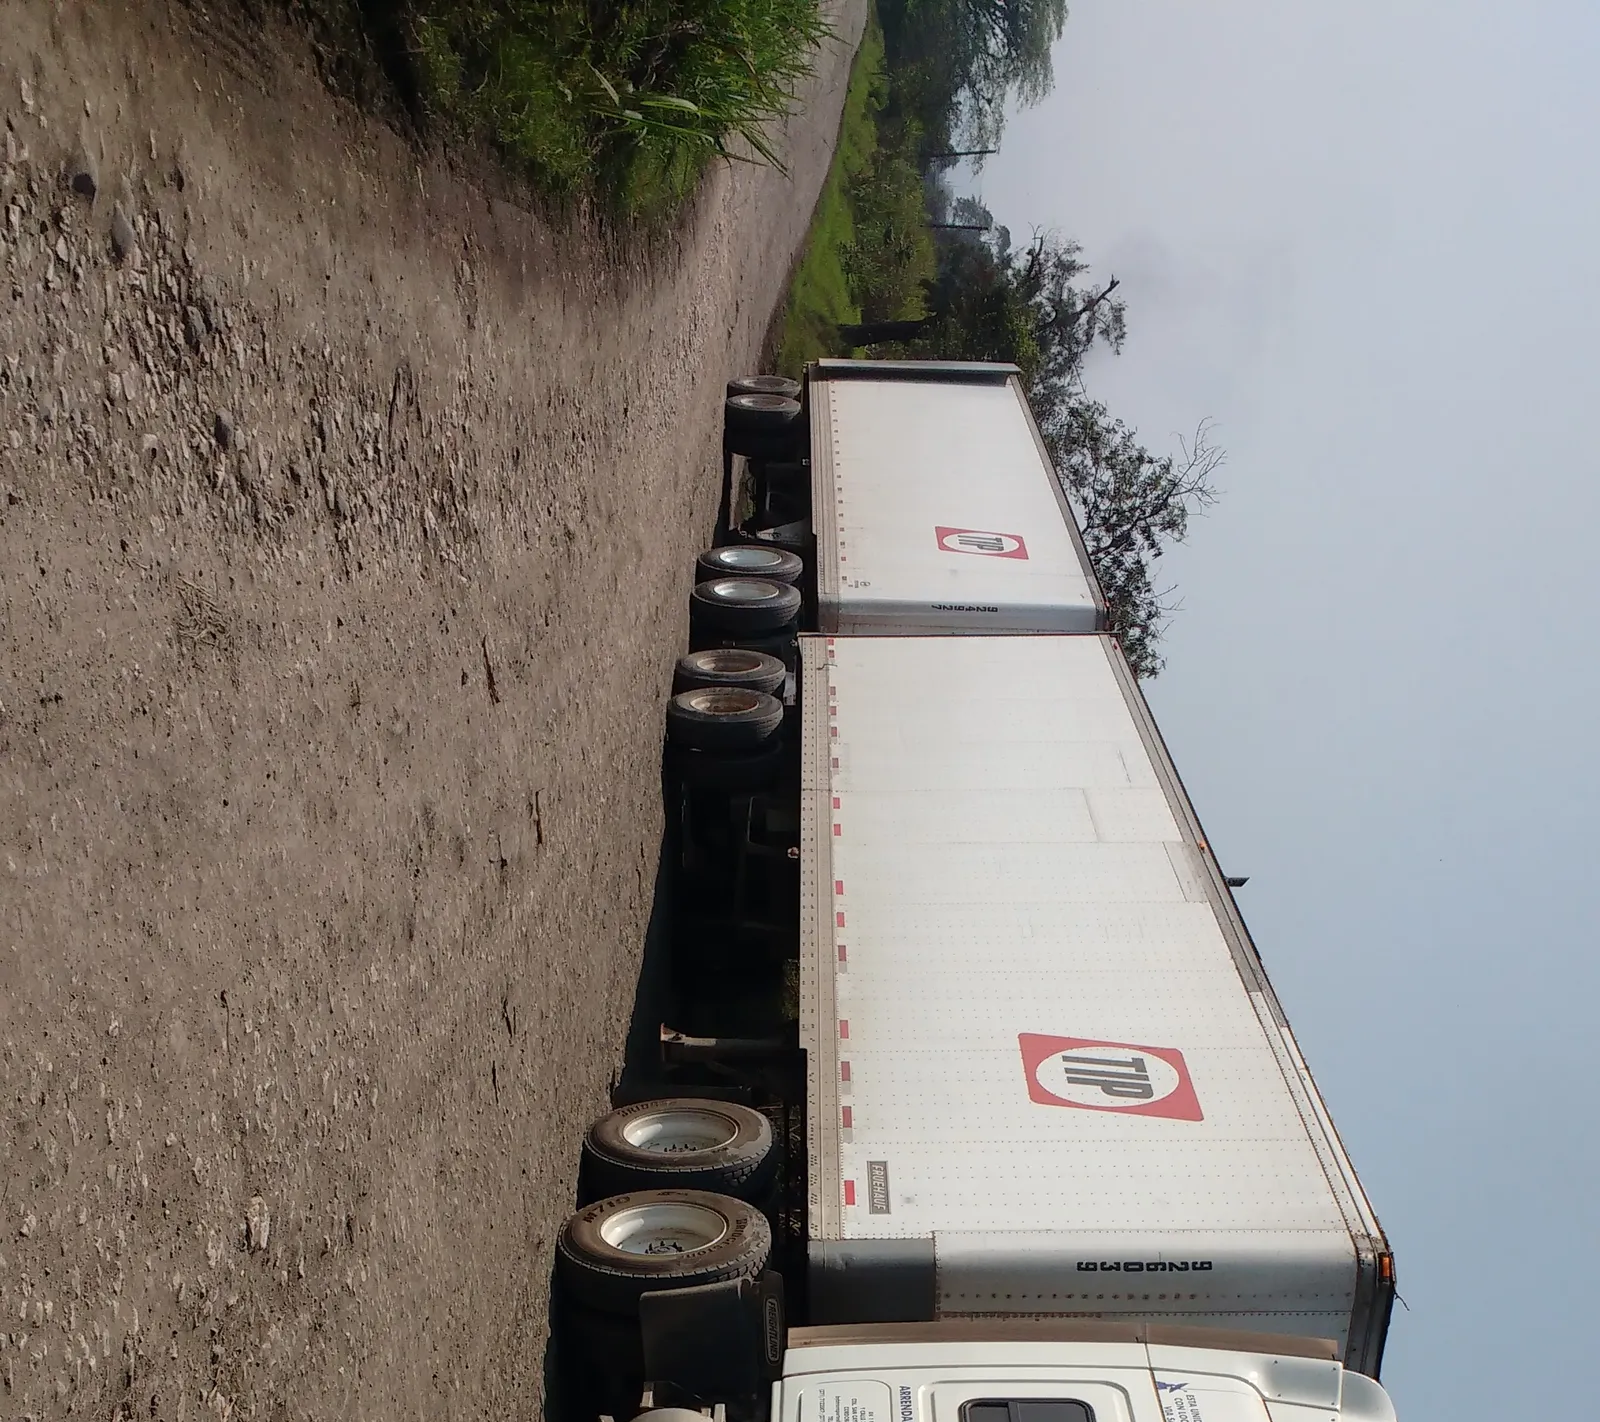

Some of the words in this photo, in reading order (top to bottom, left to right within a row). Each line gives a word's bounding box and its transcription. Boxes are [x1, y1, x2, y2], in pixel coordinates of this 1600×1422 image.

[958, 536, 1004, 551] TIP
[931, 605, 998, 613] 924927
[1062, 1055, 1154, 1099] TIP
[872, 1164, 886, 1210] FRUEHAUF
[1077, 1261, 1213, 1273] 926039
[768, 1301, 778, 1359] FREIGHTLINER
[1174, 1398, 1186, 1410] CON
[1186, 1394, 1197, 1407] ESTA
[1164, 1406, 1172, 1416] VIA
